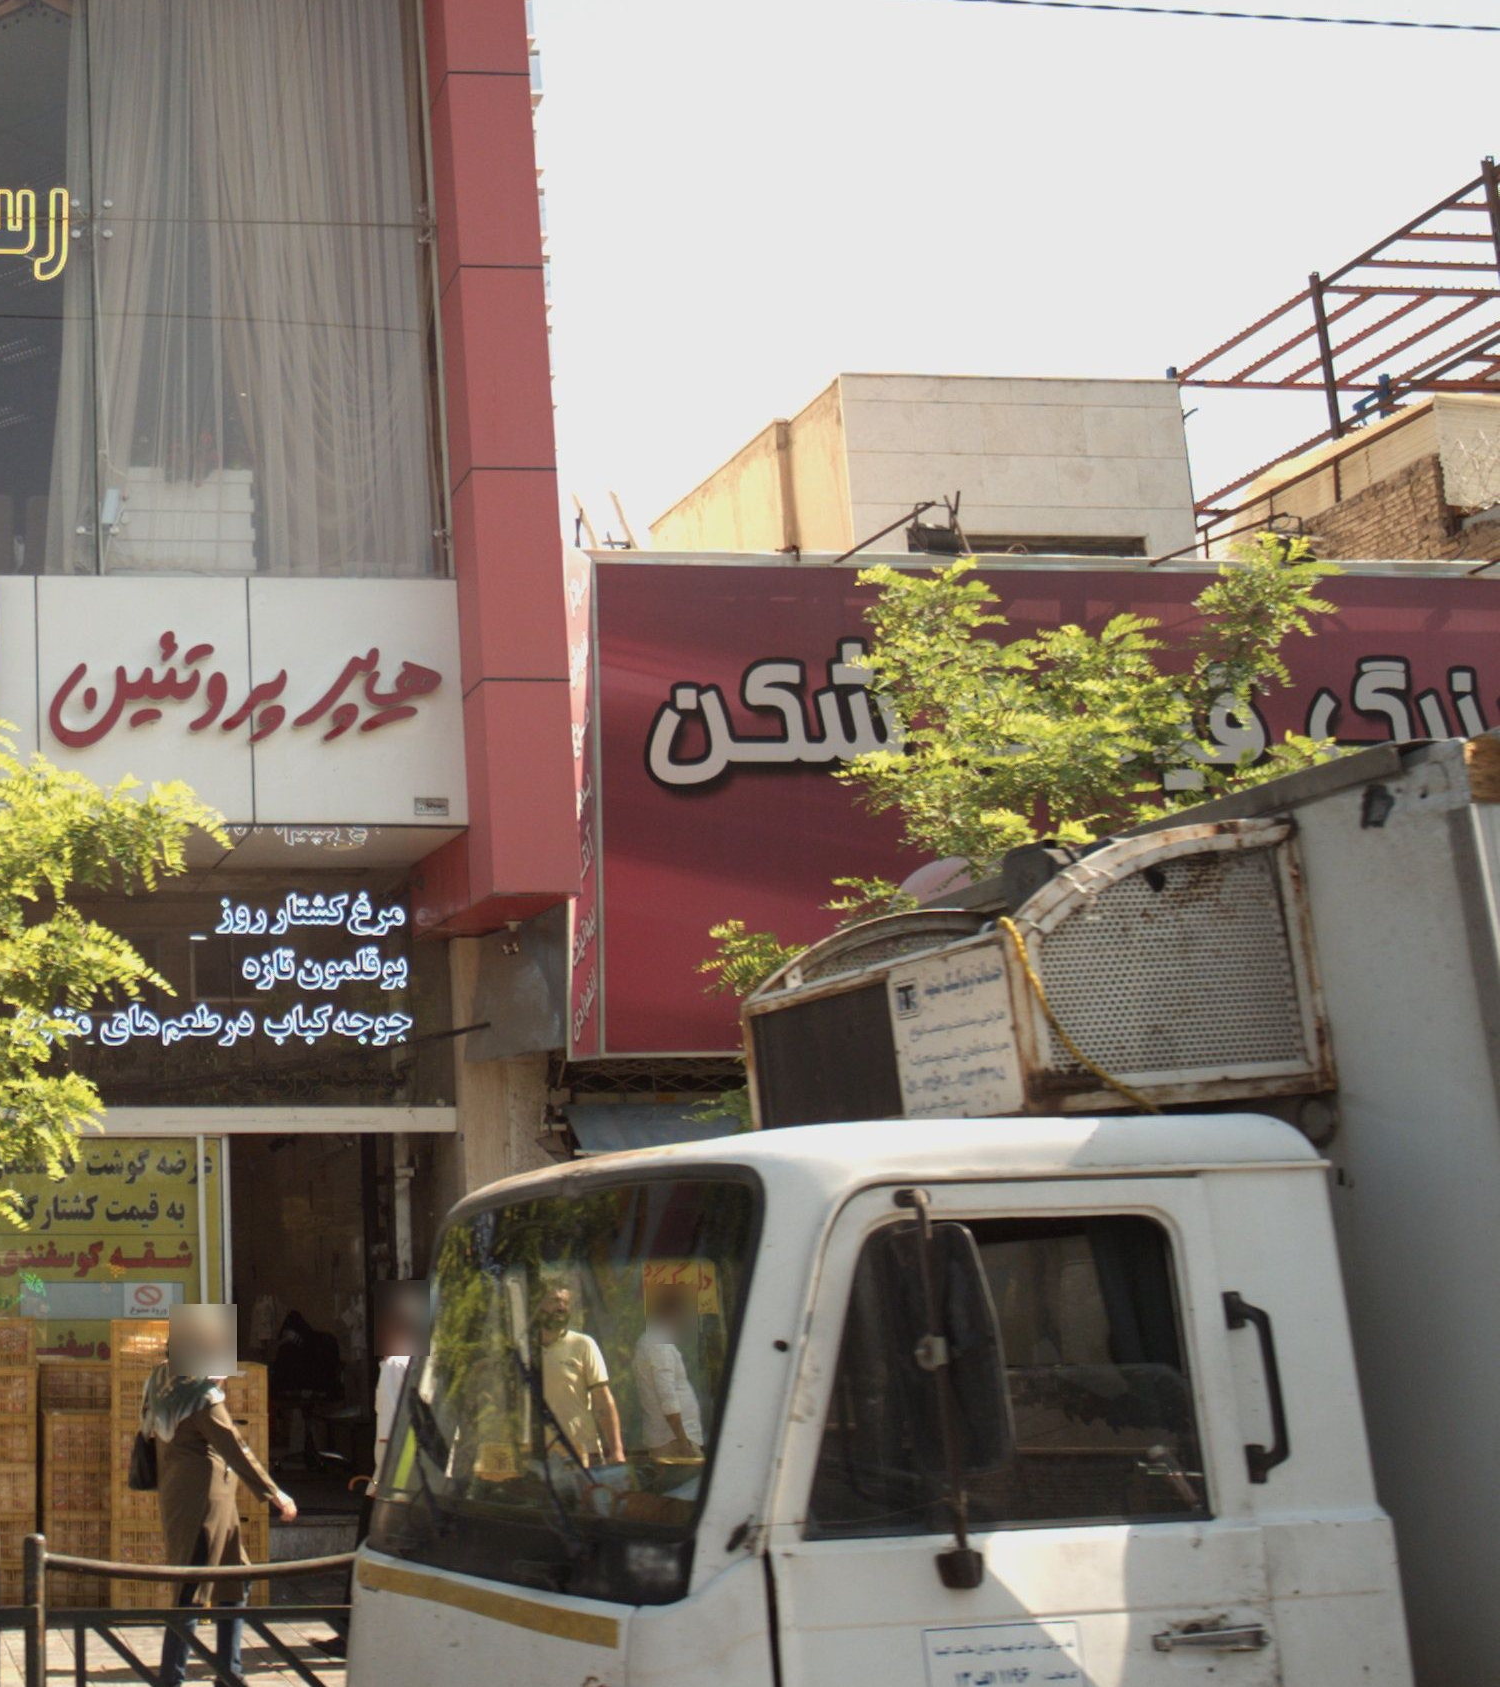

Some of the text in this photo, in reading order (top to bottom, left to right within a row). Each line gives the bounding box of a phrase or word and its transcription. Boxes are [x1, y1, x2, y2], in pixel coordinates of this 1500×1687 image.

[48, 630, 287, 748] پروتئین
[293, 646, 443, 741] هایپر
[215, 891, 406, 935] مرغ کشتار روز
[241, 947, 409, 991] بوقلمون تازه
[263, 1002, 335, 1047] کباب
[332, 1010, 413, 1047] جوجه
[86, 1148, 150, 1184] گوشت
[105, 1193, 160, 1228] قیمت
[166, 1201, 186, 1228] به
